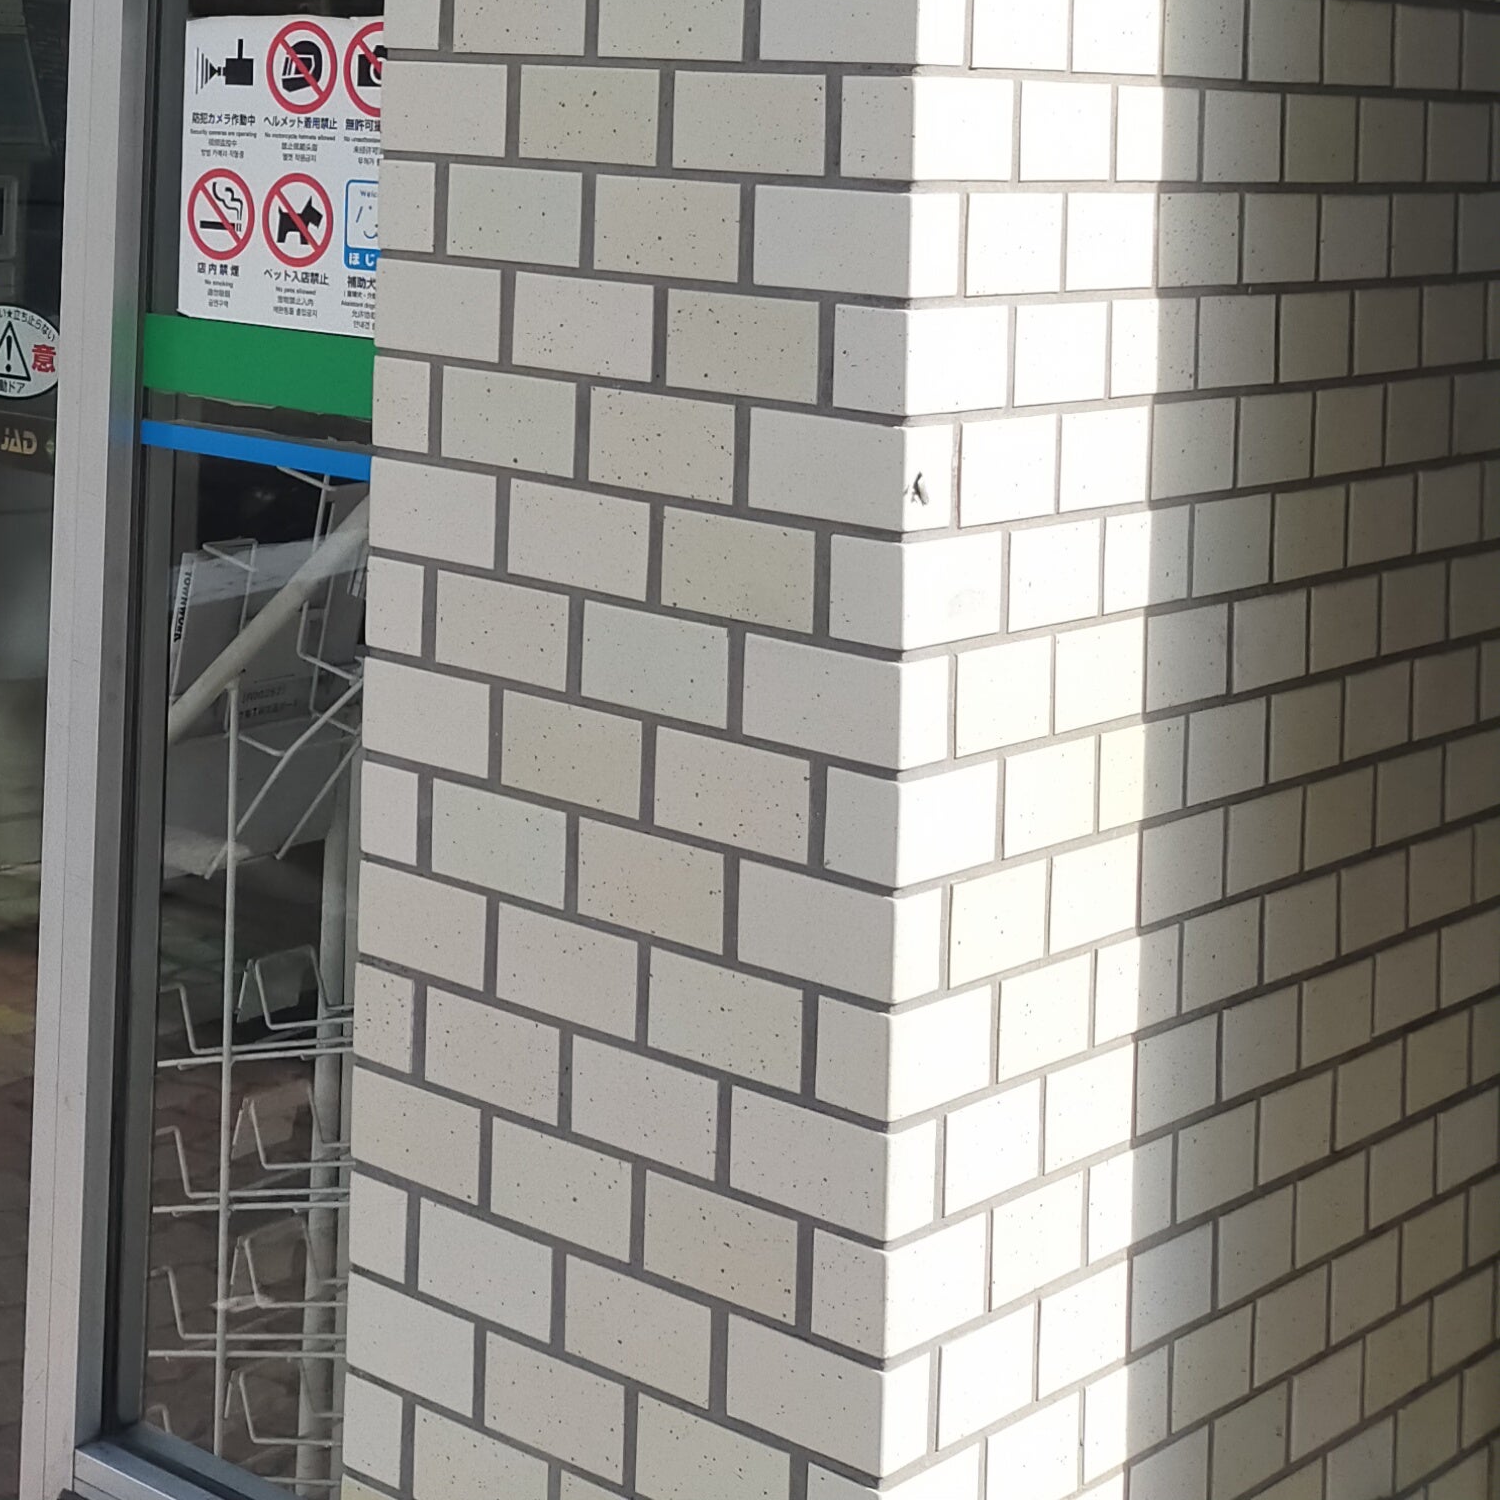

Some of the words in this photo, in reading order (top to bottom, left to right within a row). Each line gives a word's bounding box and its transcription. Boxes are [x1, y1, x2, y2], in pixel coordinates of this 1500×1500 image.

[192, 112, 256, 126] 防犯カメラ作動中
[263, 115, 338, 130] ヘルメット着用禁止
[197, 262, 239, 277] 店内禁煙
[263, 268, 329, 286] ペット入店禁止
[31, 344, 57, 373] 意
